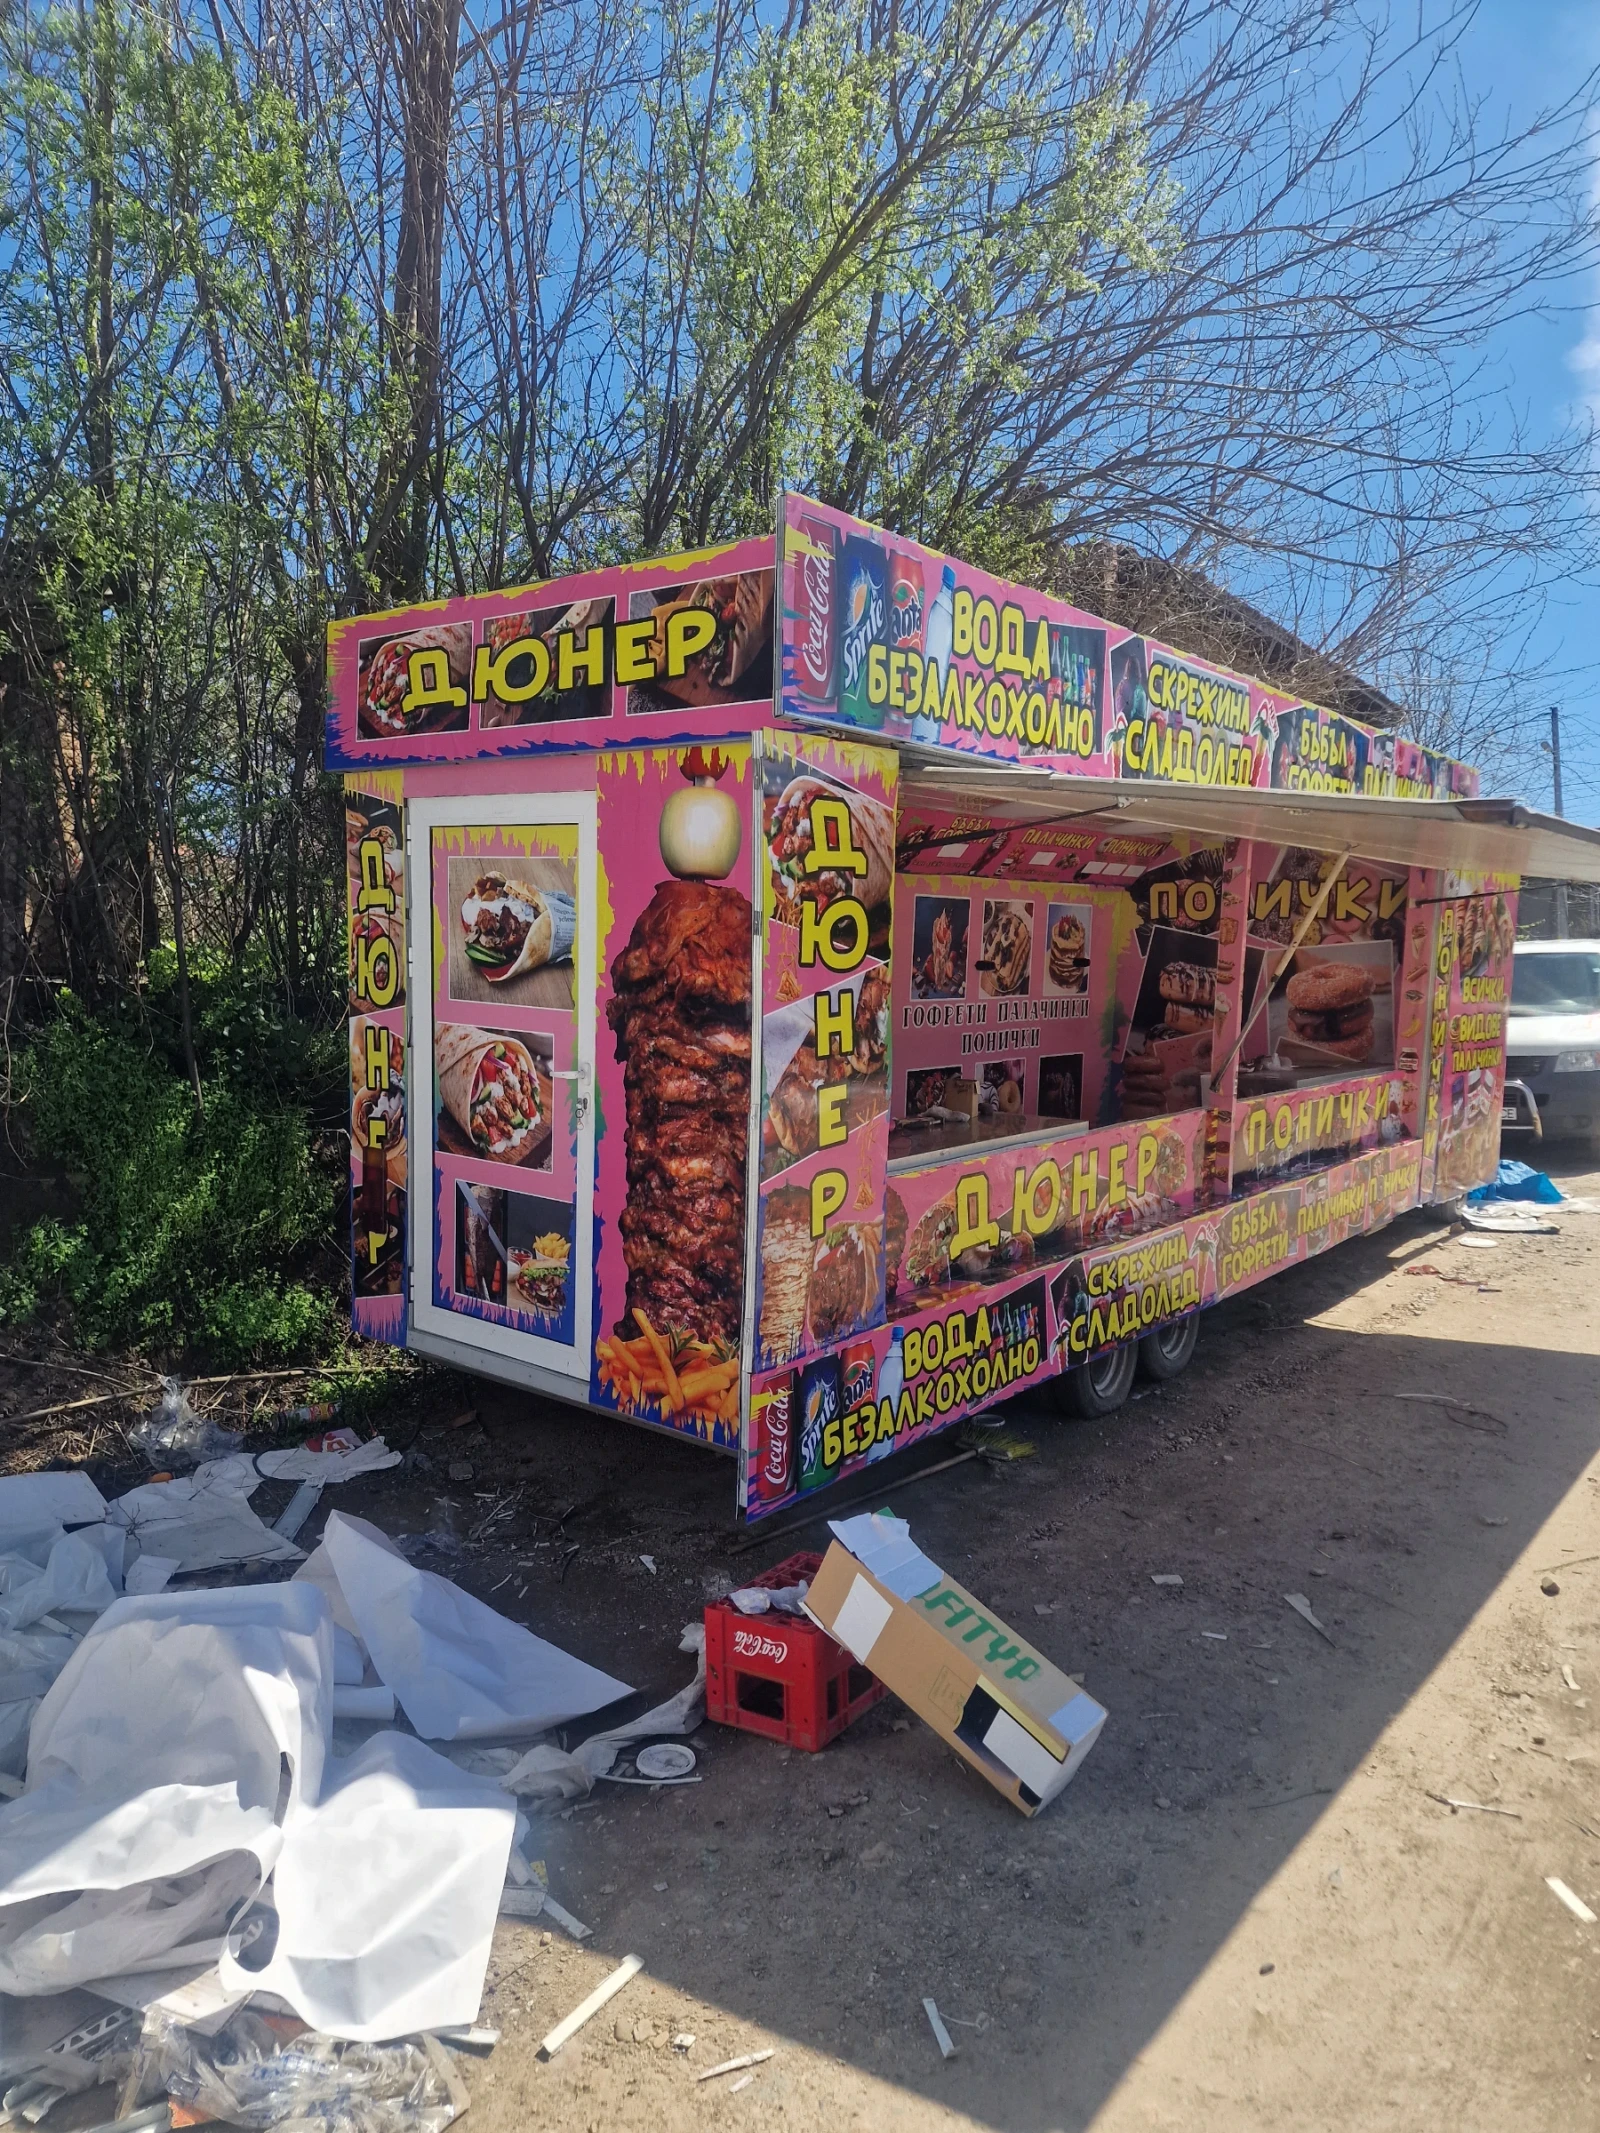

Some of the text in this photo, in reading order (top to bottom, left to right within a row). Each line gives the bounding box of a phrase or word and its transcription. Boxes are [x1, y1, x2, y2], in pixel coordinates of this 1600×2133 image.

[402, 608, 717, 713] ДЮНЕР
[843, 588, 884, 689] Sprite
[952, 588, 1050, 680] ВОДА
[867, 644, 1094, 757] БЕЗАЛКОХОЛНО
[1149, 664, 1250, 734] СКРЕЖИНА
[1125, 720, 1252, 787] СЛАДОЛЕД
[1301, 718, 1347, 767] БЪБЪЛ
[1021, 828, 1097, 850] ПАЛАЧИНКИ
[800, 799, 868, 1240] ДЮНЕР
[903, 998, 1090, 1028] ГОФРЕТИ ПАЛАЧИНКИ
[1462, 976, 1505, 1004] ВСИЧКИ
[961, 1027, 1041, 1054] ПОНИЧКИ
[1452, 1046, 1503, 1074] ПАЛАЧИНКИ
[1459, 1013, 1502, 1043] ВИДОВЕ
[1248, 1081, 1391, 1157] ПОНИЧКИ
[950, 1135, 1158, 1260] ДЮНЕР
[1231, 1202, 1278, 1244] БЪБЪЛ
[1298, 1183, 1365, 1236] ПАЛАЧИНКИ
[1088, 1232, 1189, 1296] СКРЕЖИНА
[1222, 1230, 1289, 1286] ГОФРЕТИ
[904, 1306, 992, 1379] ВОДА
[1070, 1269, 1200, 1352] СЛАДОЛЕД
[801, 1384, 836, 1472] Sprite
[824, 1338, 1039, 1467] БЕЗАЛКОХОЛНО
[734, 1631, 788, 1664] Coca-Cola
